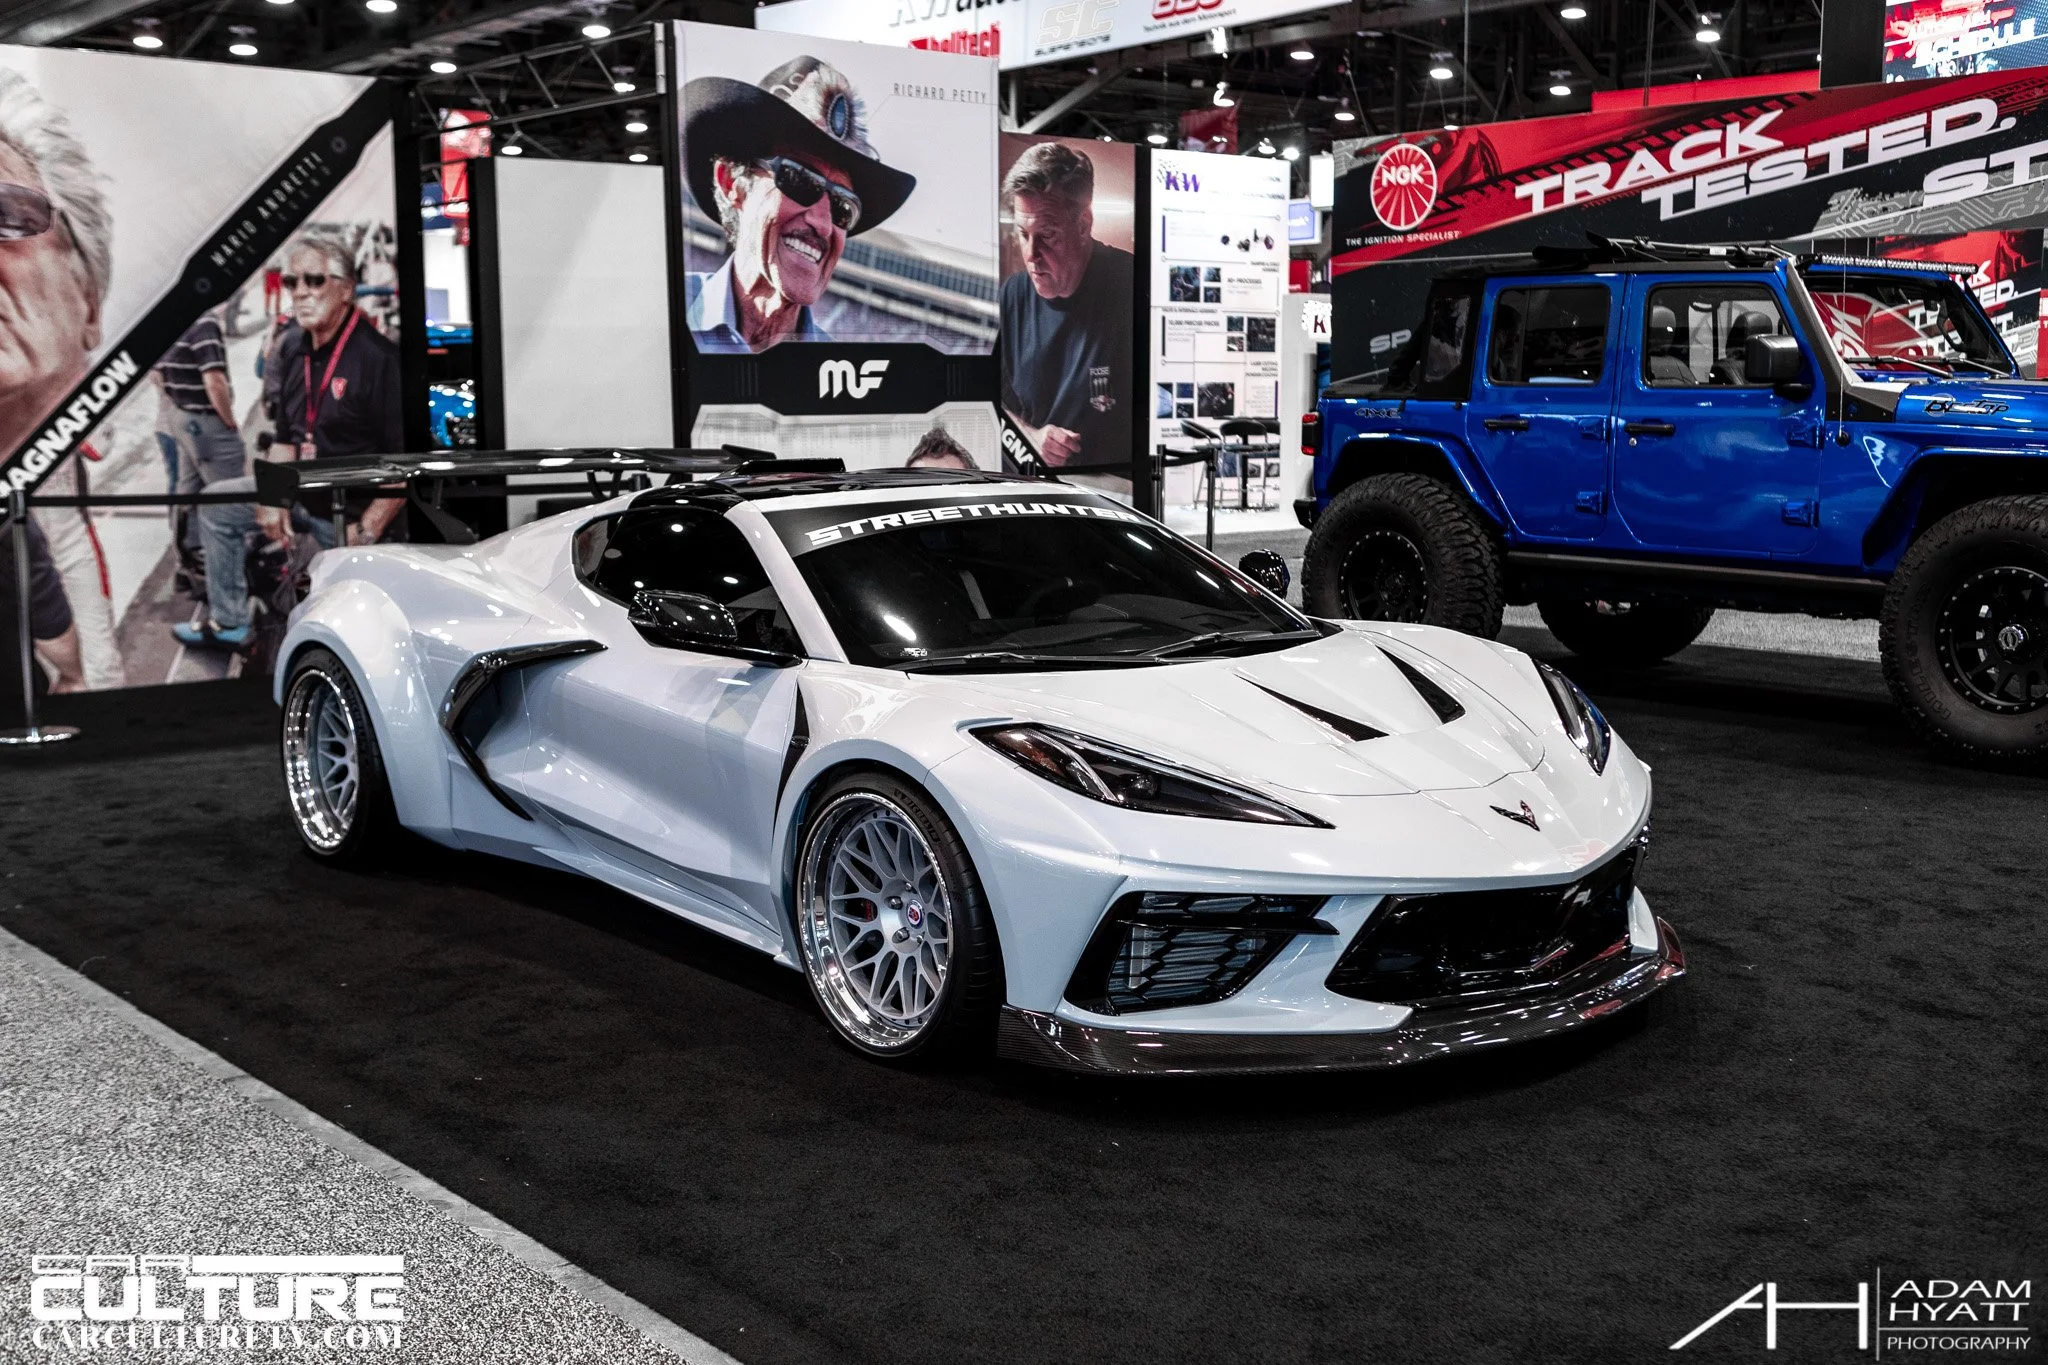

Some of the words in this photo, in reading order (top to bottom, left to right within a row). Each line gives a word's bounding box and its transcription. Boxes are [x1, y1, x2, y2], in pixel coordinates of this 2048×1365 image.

[1914, 18, 2037, 68] SCHEDULE
[893, 83, 945, 100] RICHARD
[953, 89, 987, 104] PETTY
[1381, 163, 1425, 187] NGK
[1515, 109, 1785, 215] TRACK
[1641, 98, 2018, 222] TESTED.
[1165, 171, 1200, 193] KW
[210, 219, 258, 267] MARIO
[256, 151, 323, 220] ANDRETTI
[1346, 238, 1362, 247] THE
[1365, 234, 1404, 245] IGNITION
[1407, 230, 1461, 243] SPECIALIST
[805, 503, 1139, 546] STREETHUNTER
